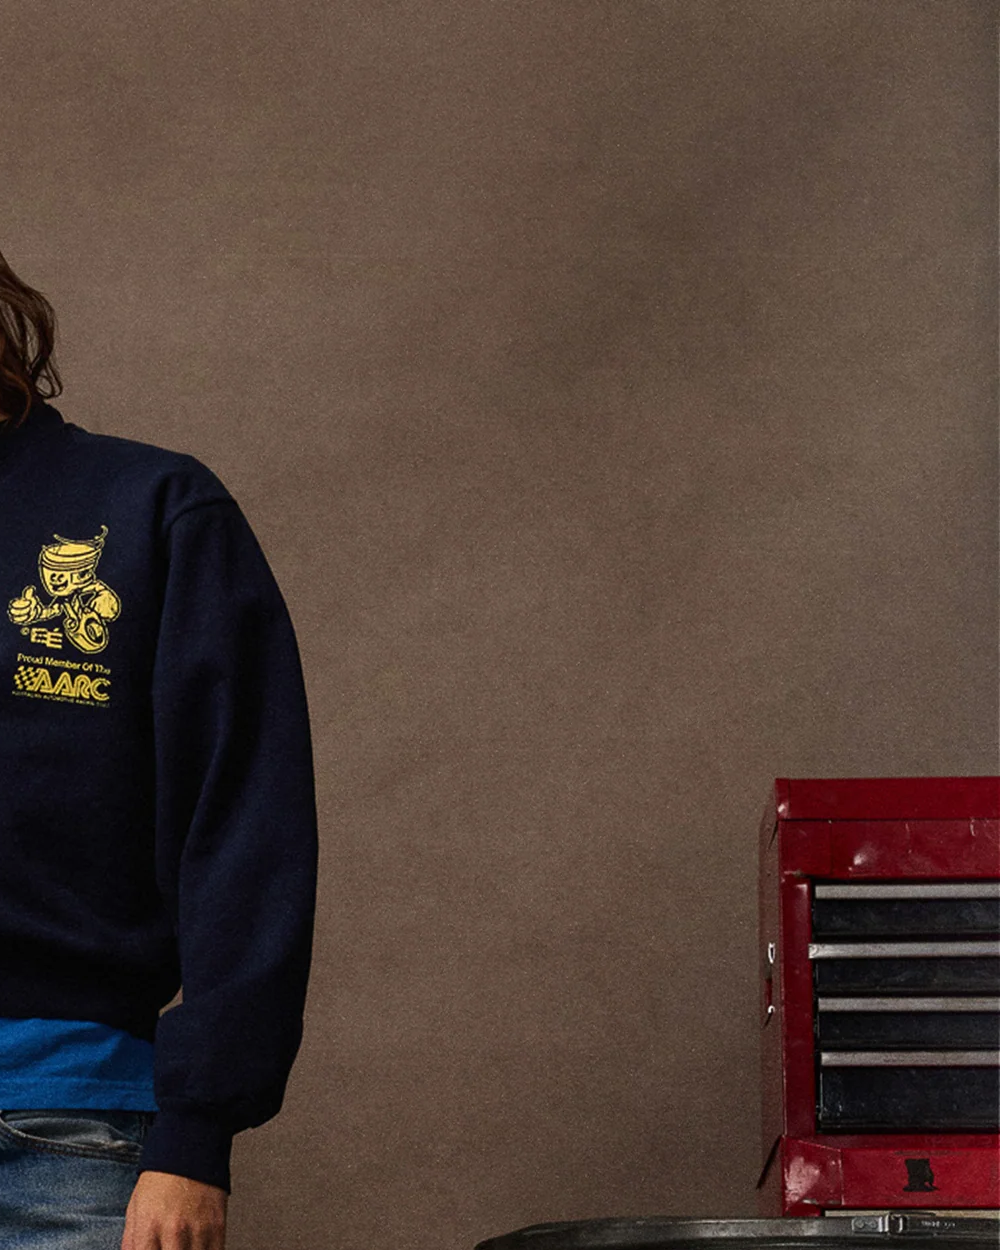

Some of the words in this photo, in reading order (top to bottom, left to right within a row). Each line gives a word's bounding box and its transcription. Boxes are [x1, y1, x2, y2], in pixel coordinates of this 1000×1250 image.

[17, 652, 44, 665] Proud
[45, 656, 81, 670] Member
[81, 662, 94, 672] Of
[32, 667, 111, 702] AARC
